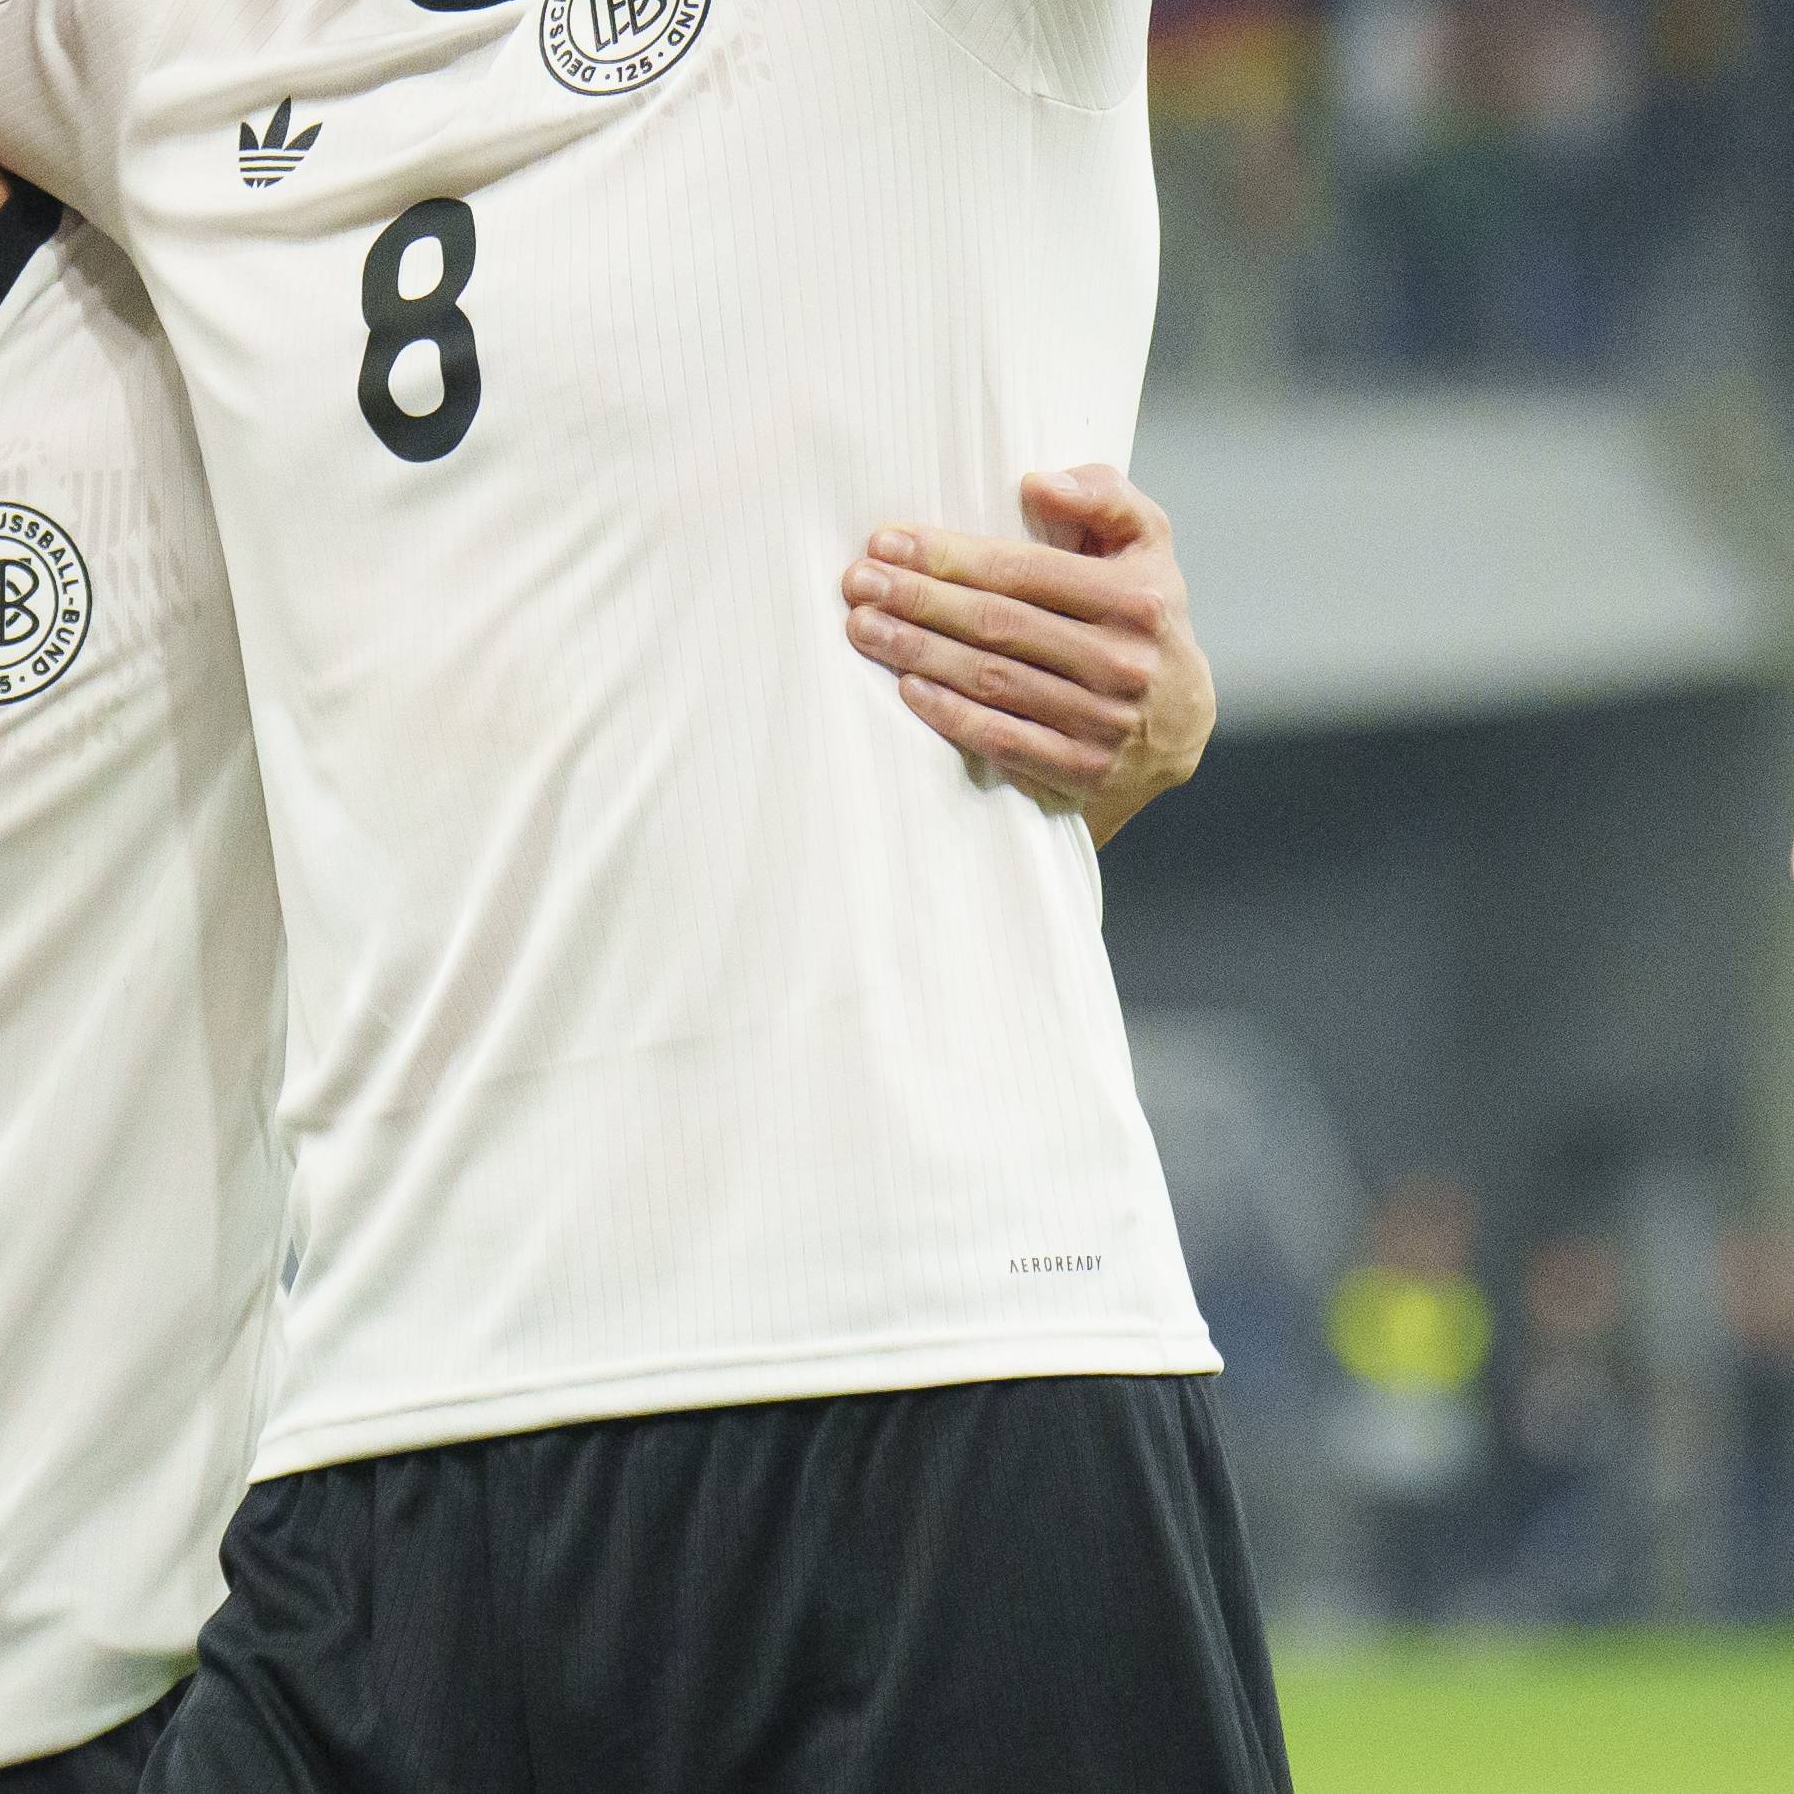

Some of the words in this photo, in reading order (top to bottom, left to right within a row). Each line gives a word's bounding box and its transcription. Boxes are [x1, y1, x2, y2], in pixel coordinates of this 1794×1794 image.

[615, 55, 654, 83] 125
[357, 196, 482, 464] 8
[1009, 1255, 1102, 1274] AEROREADY
